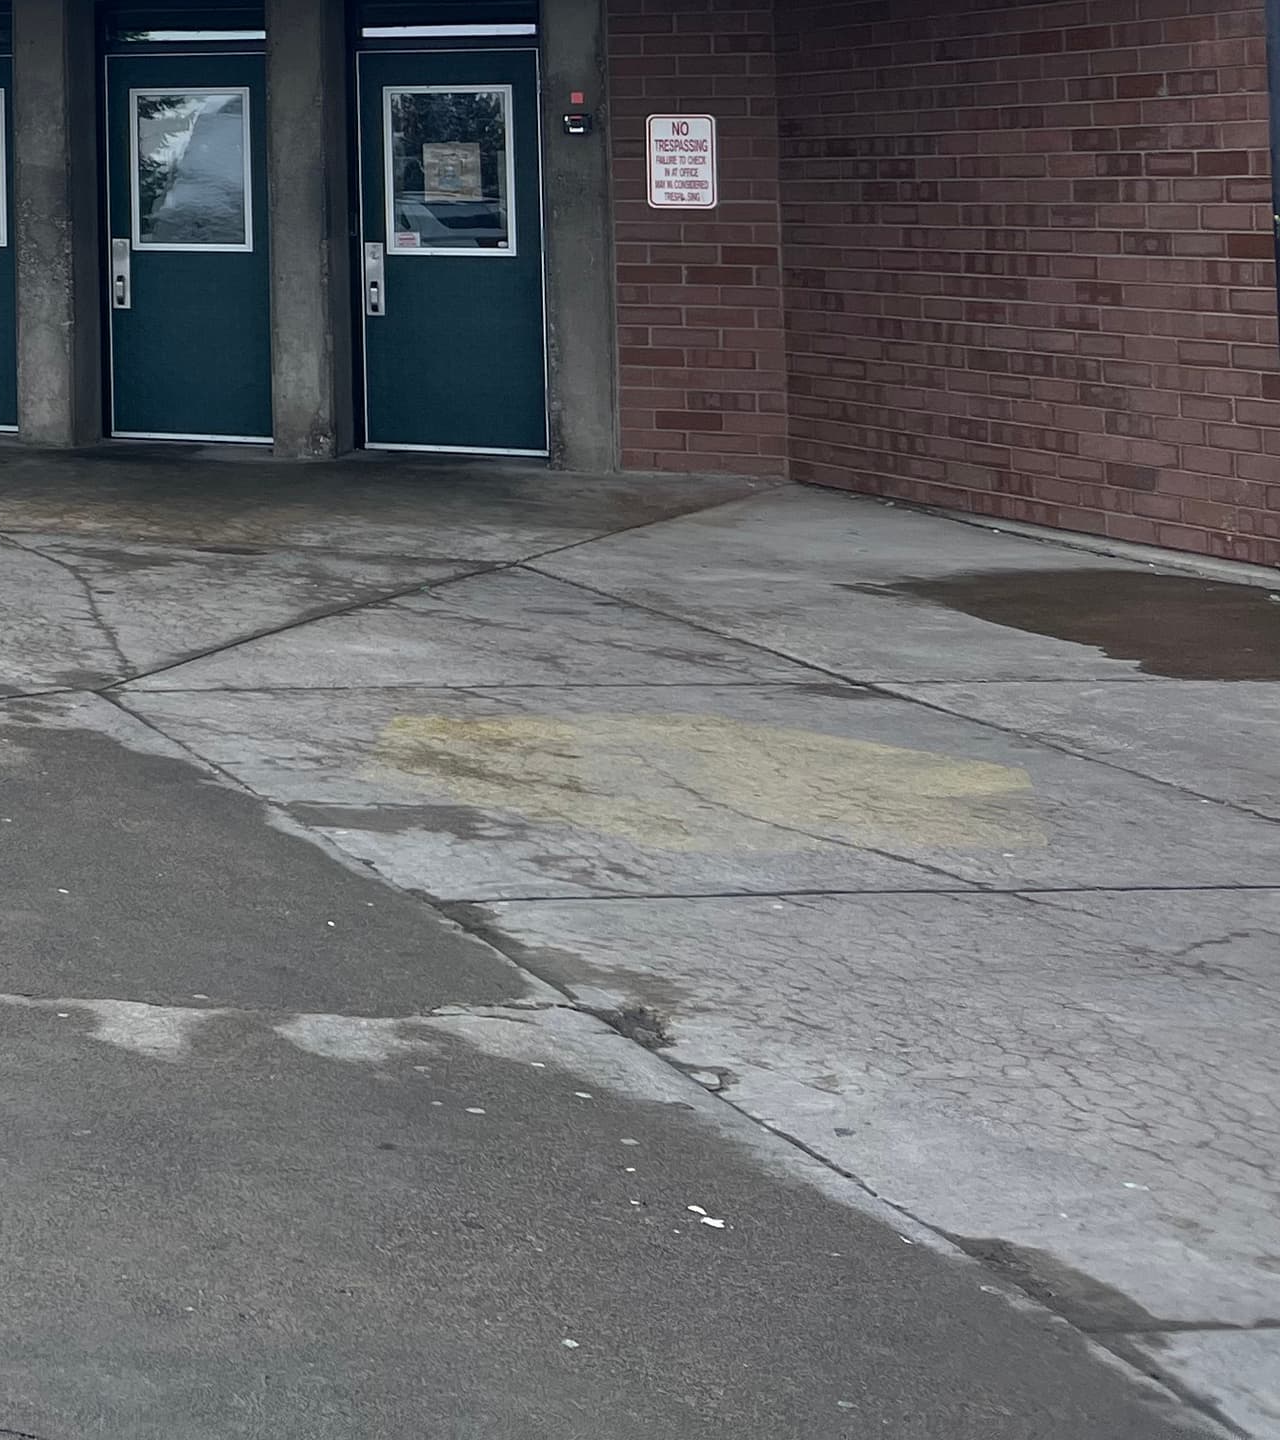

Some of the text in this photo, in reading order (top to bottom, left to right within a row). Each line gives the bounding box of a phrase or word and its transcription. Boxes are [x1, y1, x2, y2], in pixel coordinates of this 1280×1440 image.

[672, 121, 689, 136] NO
[654, 139, 708, 152] TRESPASSING
[655, 155, 706, 165] FAILURE TO CHECK
[664, 168, 699, 177] IN AT OFFICE
[674, 180, 709, 190] CONSIDERED
